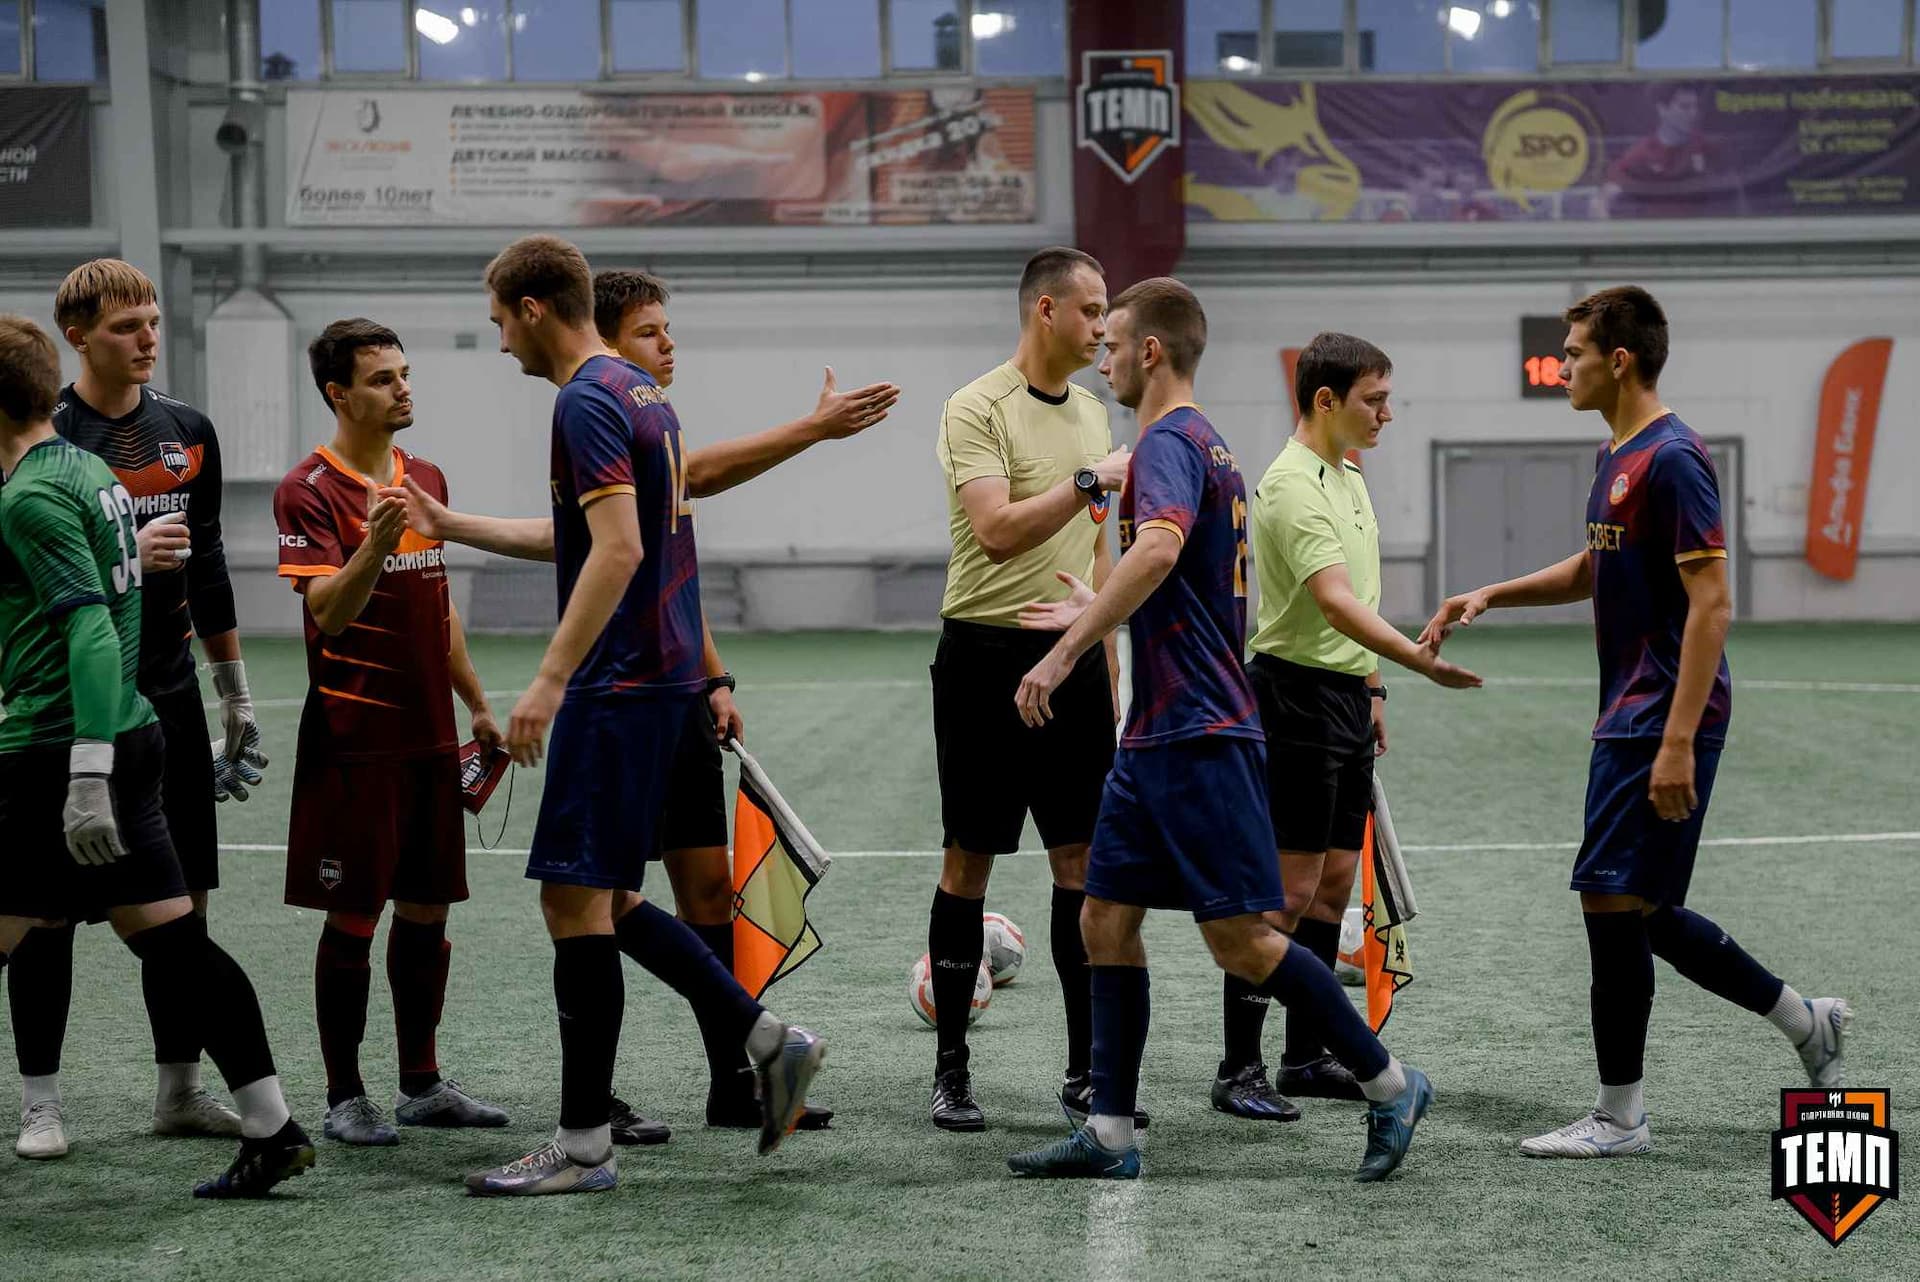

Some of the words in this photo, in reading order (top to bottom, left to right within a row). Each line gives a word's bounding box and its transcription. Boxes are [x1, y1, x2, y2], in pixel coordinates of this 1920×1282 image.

[1087, 88, 1170, 134] ТЕМП
[663, 430, 693, 534] 14
[134, 493, 190, 516] ИНВЕСТ
[1587, 522, 1625, 552] СВЕТ
[385, 548, 447, 574] ОДИНВЕС
